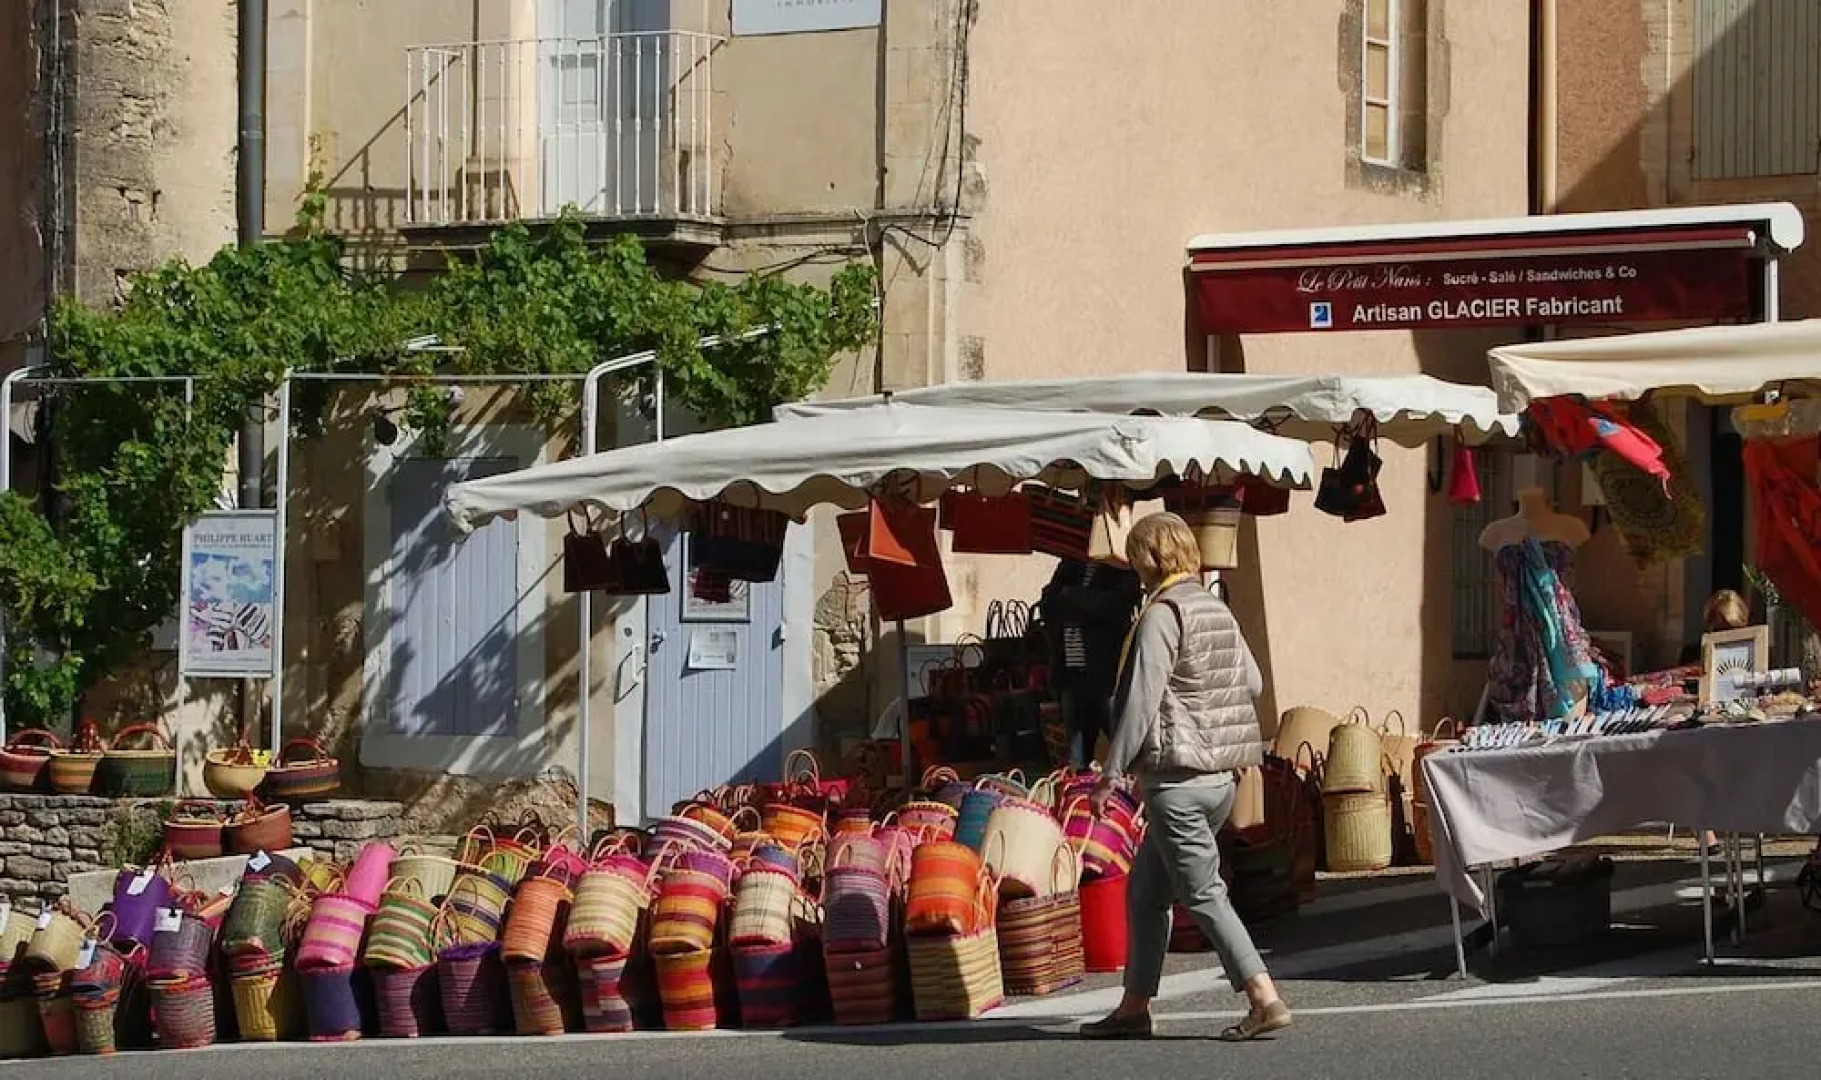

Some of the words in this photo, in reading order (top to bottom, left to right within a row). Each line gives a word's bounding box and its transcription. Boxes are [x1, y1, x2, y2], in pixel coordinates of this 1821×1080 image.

[1297, 268, 1324, 293] Le
[1443, 271, 1479, 285] Sucré
[1489, 270, 1516, 283] Salé
[1527, 267, 1602, 282] Sandwiches
[1605, 266, 1615, 279] &
[1618, 265, 1638, 278] Co
[1352, 303, 1422, 323] Artisan
[1427, 298, 1520, 320] GLACIER
[1525, 294, 1624, 316] Fabricant
